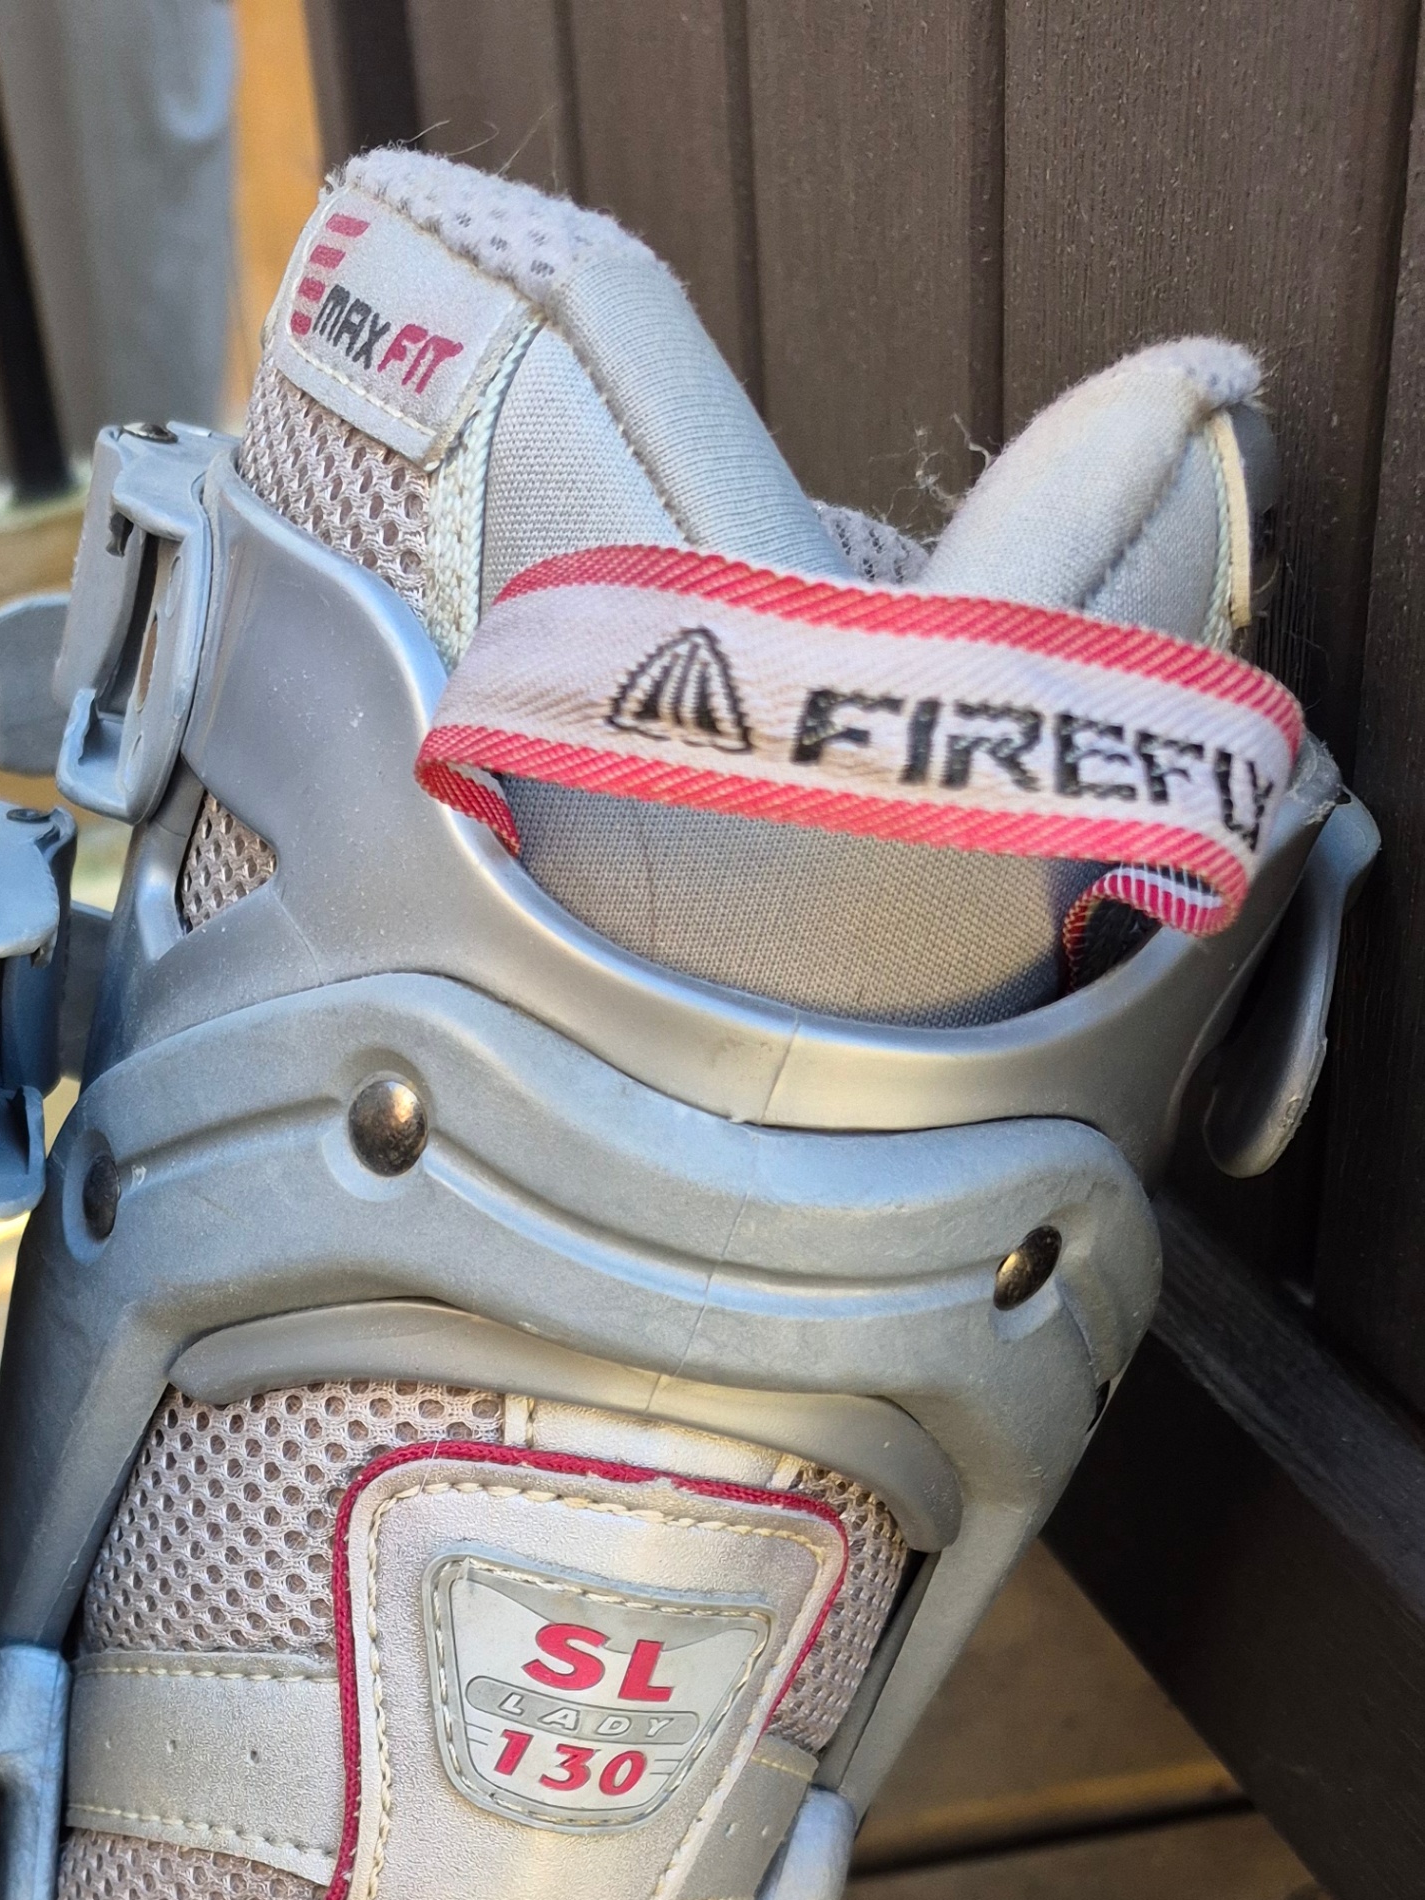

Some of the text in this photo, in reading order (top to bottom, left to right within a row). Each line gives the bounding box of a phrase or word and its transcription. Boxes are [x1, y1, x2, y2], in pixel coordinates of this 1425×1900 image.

[788, 686, 1274, 852] FIREFLY
[520, 1622, 676, 1703] SL
[498, 1691, 675, 1738] LADY
[493, 1729, 648, 1797] 130
